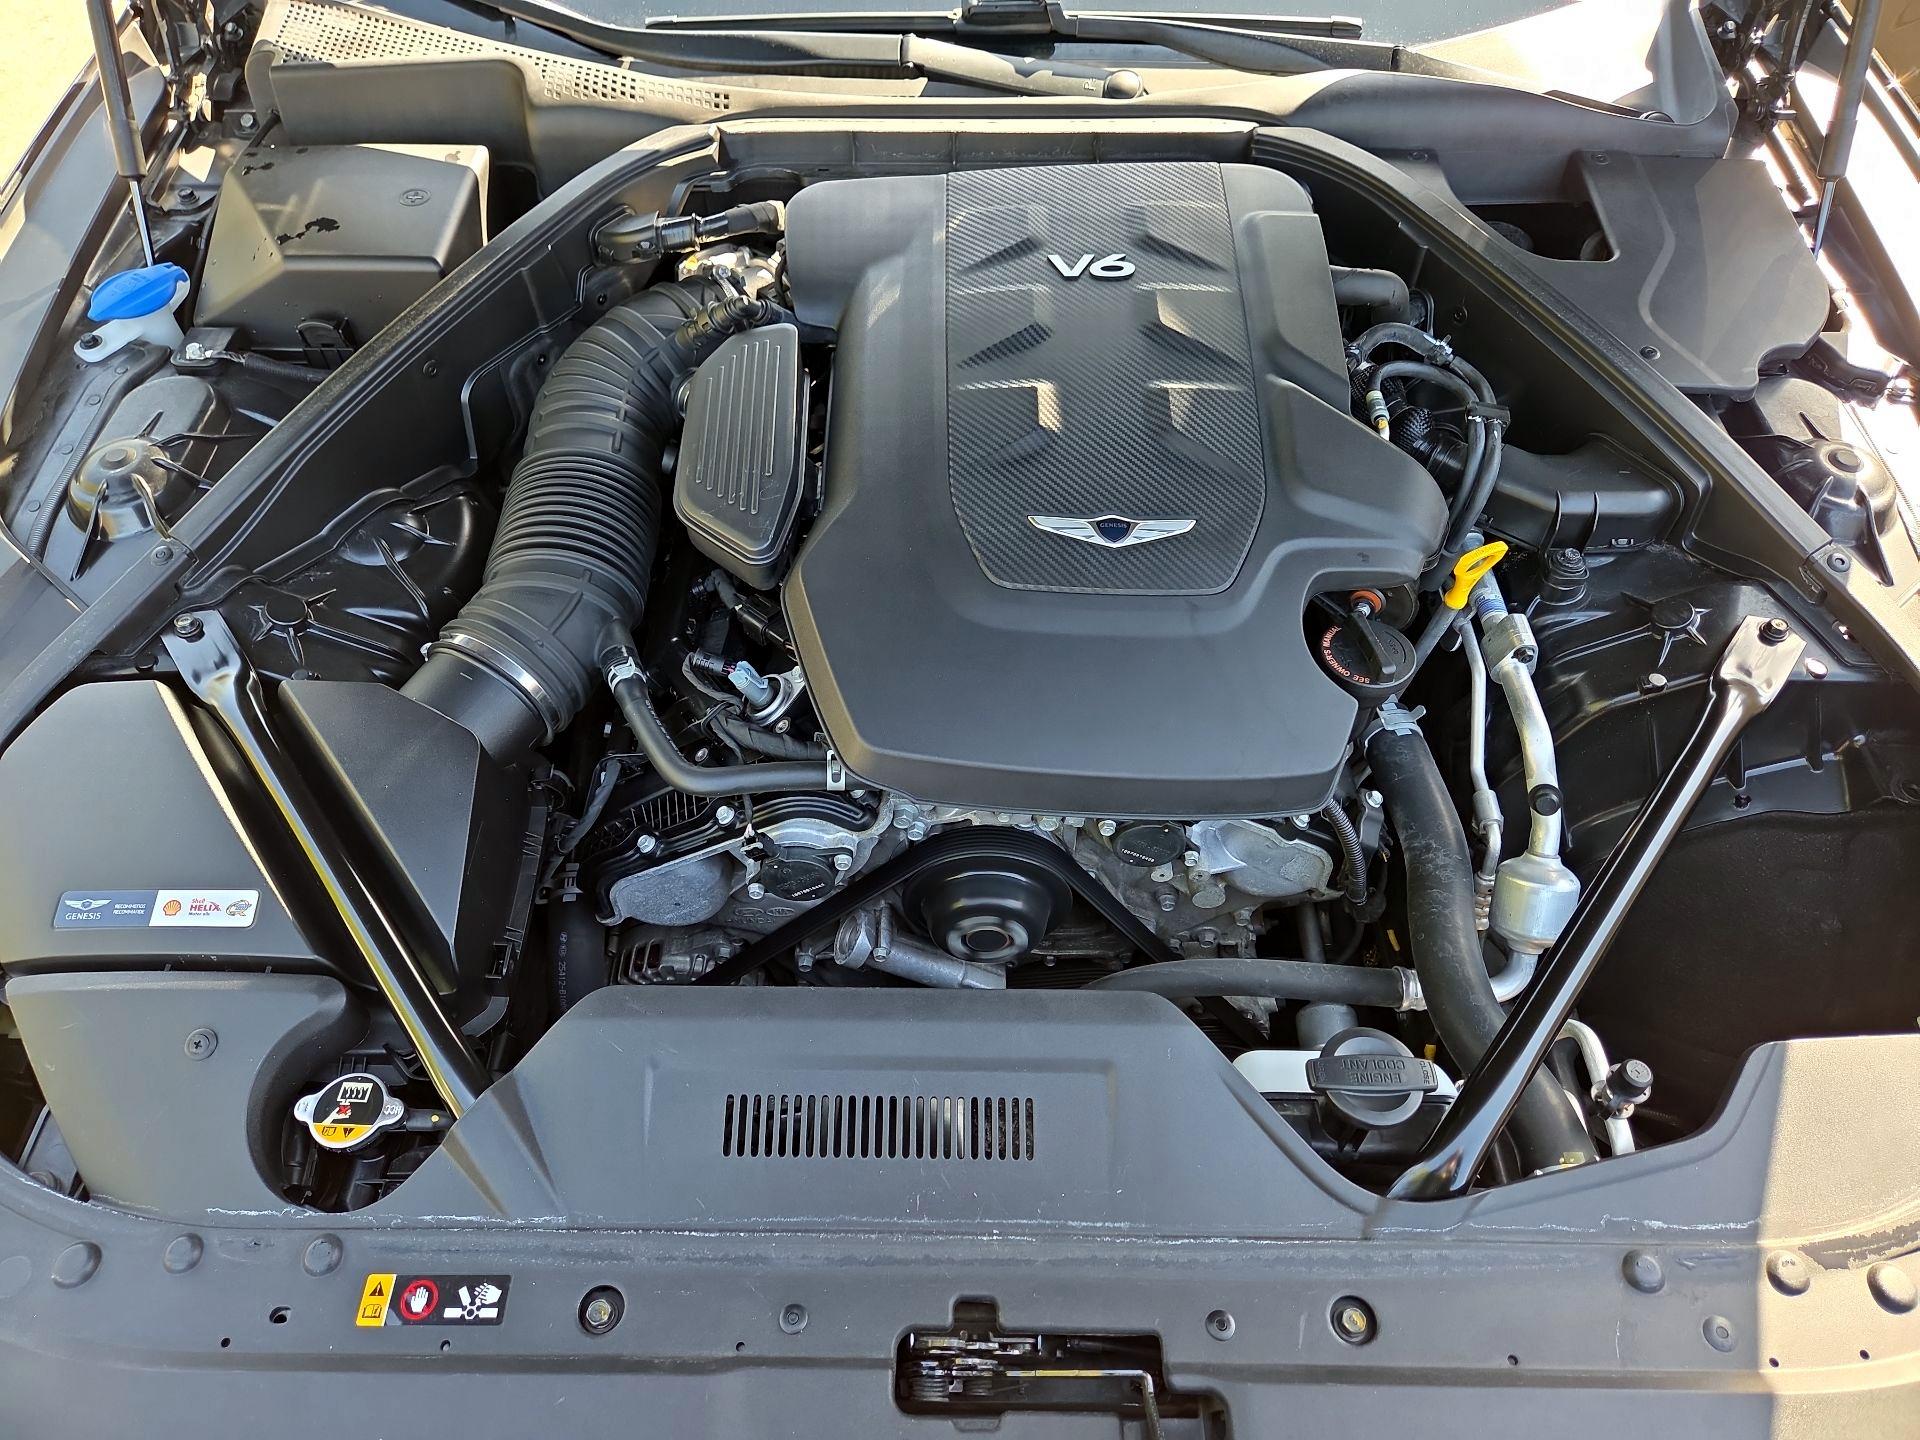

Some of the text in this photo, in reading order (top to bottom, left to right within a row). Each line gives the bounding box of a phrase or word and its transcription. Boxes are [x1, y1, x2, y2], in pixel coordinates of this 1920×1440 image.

[1047, 253, 1136, 279] V6
[1353, 674, 1370, 684] SEE
[189, 904, 220, 912] HELIX
[65, 912, 102, 920] GENESIS
[1341, 1059, 1406, 1071] COOLANT
[1352, 1072, 1402, 1084] ENGINE
[1419, 1060, 1431, 1085] CLOSE
